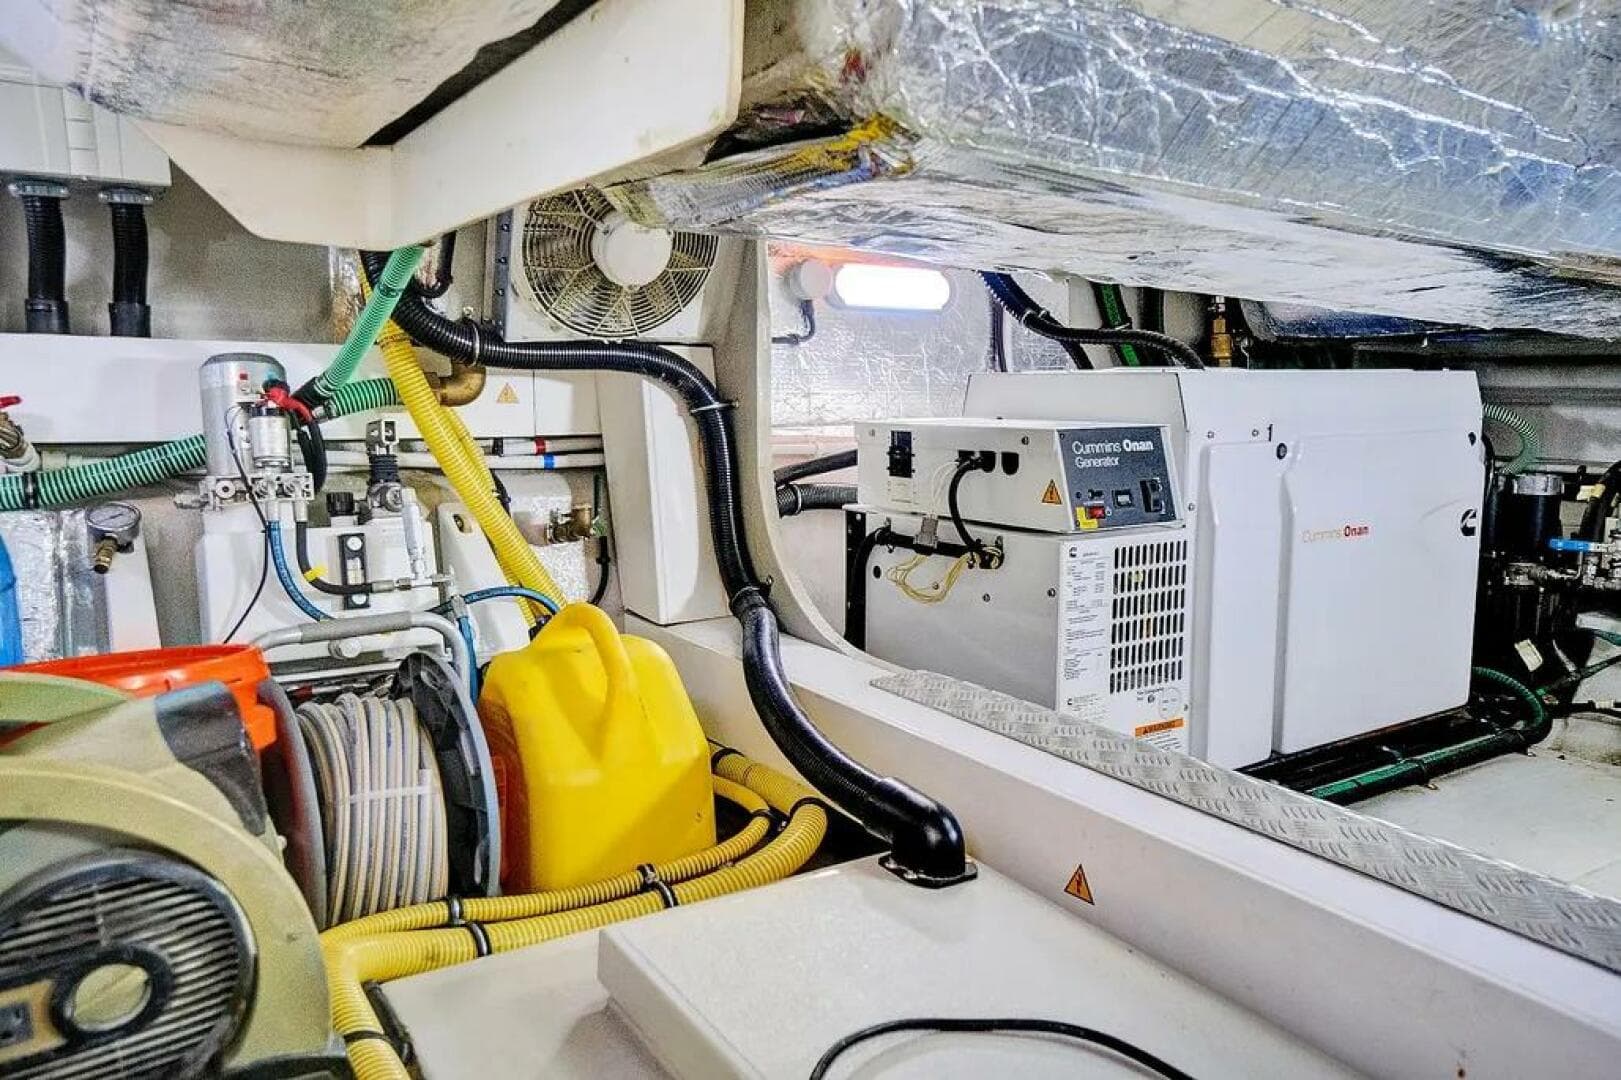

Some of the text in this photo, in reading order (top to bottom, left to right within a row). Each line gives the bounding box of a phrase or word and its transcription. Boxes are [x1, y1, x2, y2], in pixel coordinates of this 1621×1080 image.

[1072, 439, 1154, 455] Cummins Onan
[1075, 456, 1119, 468] Generator
[1344, 525, 1369, 537] Onan
